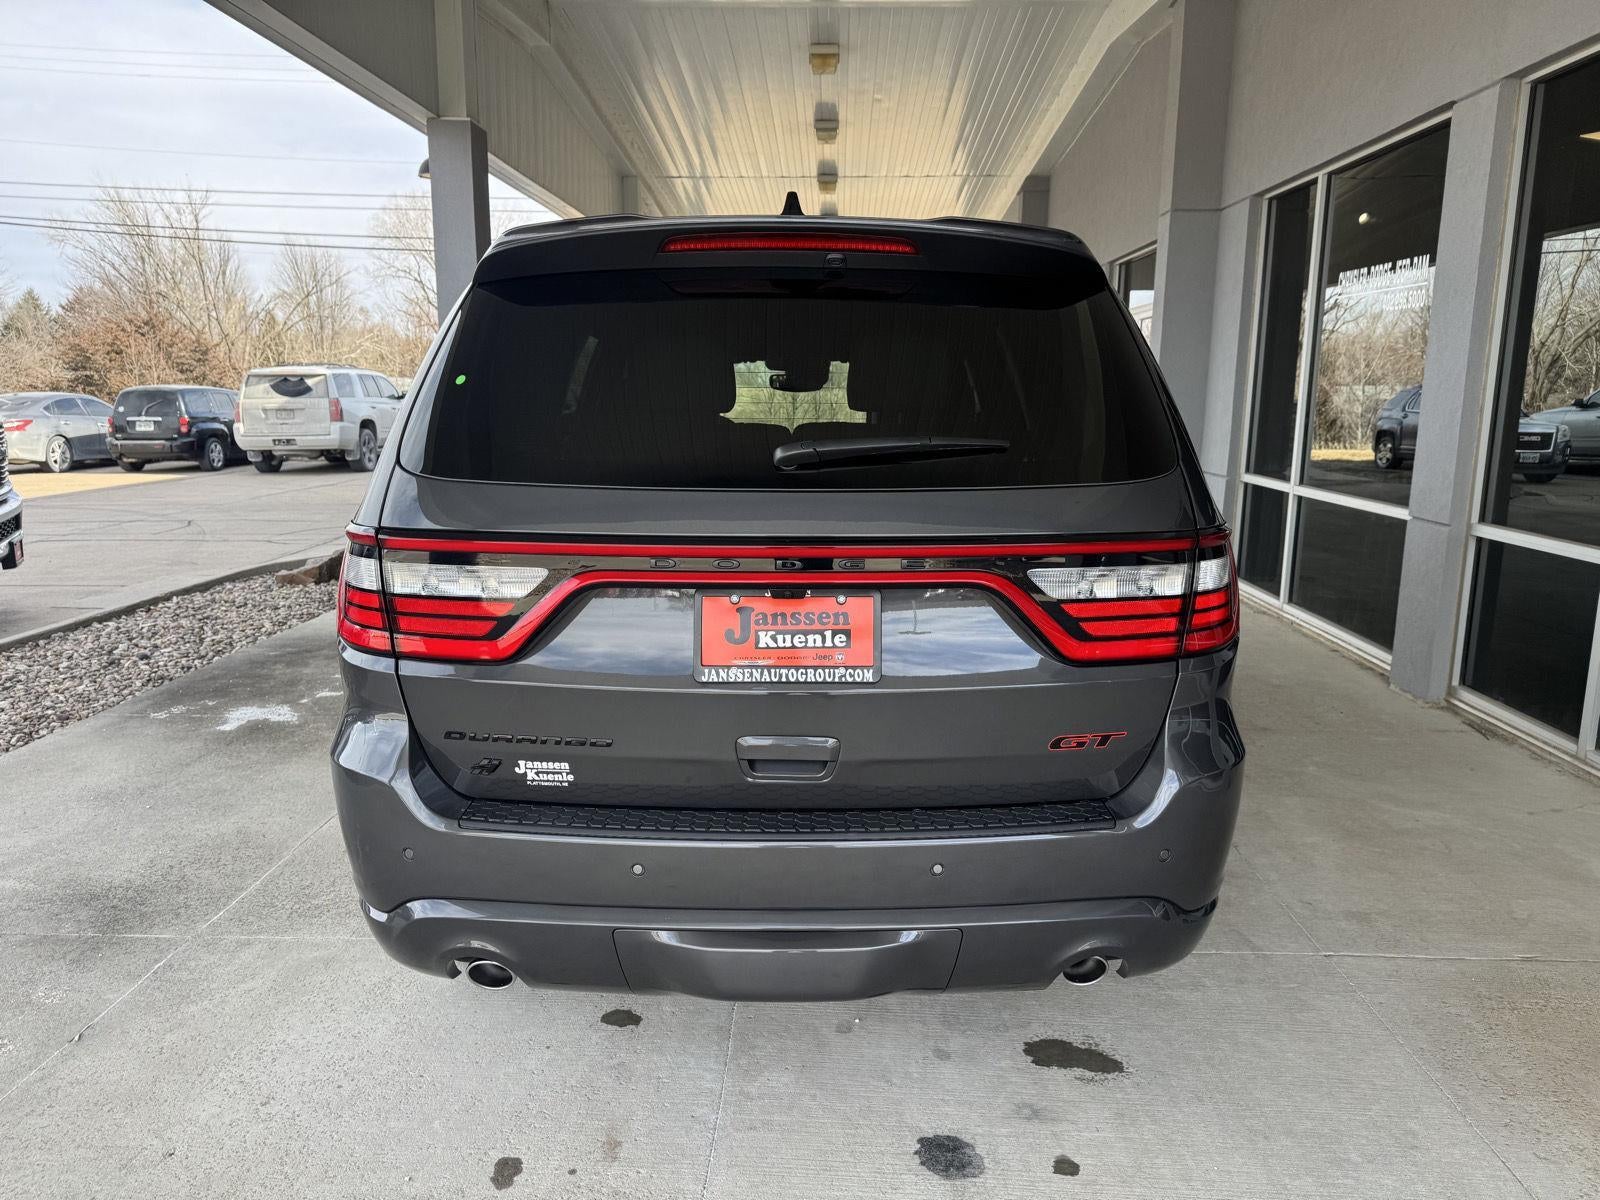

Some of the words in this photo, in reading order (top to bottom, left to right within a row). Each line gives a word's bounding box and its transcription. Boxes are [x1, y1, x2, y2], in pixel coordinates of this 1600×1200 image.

[649, 557, 926, 570] DODGE
[724, 606, 851, 646] Janssen
[757, 629, 848, 648] Kuenle
[812, 652, 833, 662] Jeep
[701, 667, 874, 683] JANSSENAUTOGROUP.COM
[443, 730, 614, 748] DURANGO
[1047, 731, 1128, 751] GT
[514, 759, 570, 774] Janssen
[525, 769, 575, 781] Kuenle
